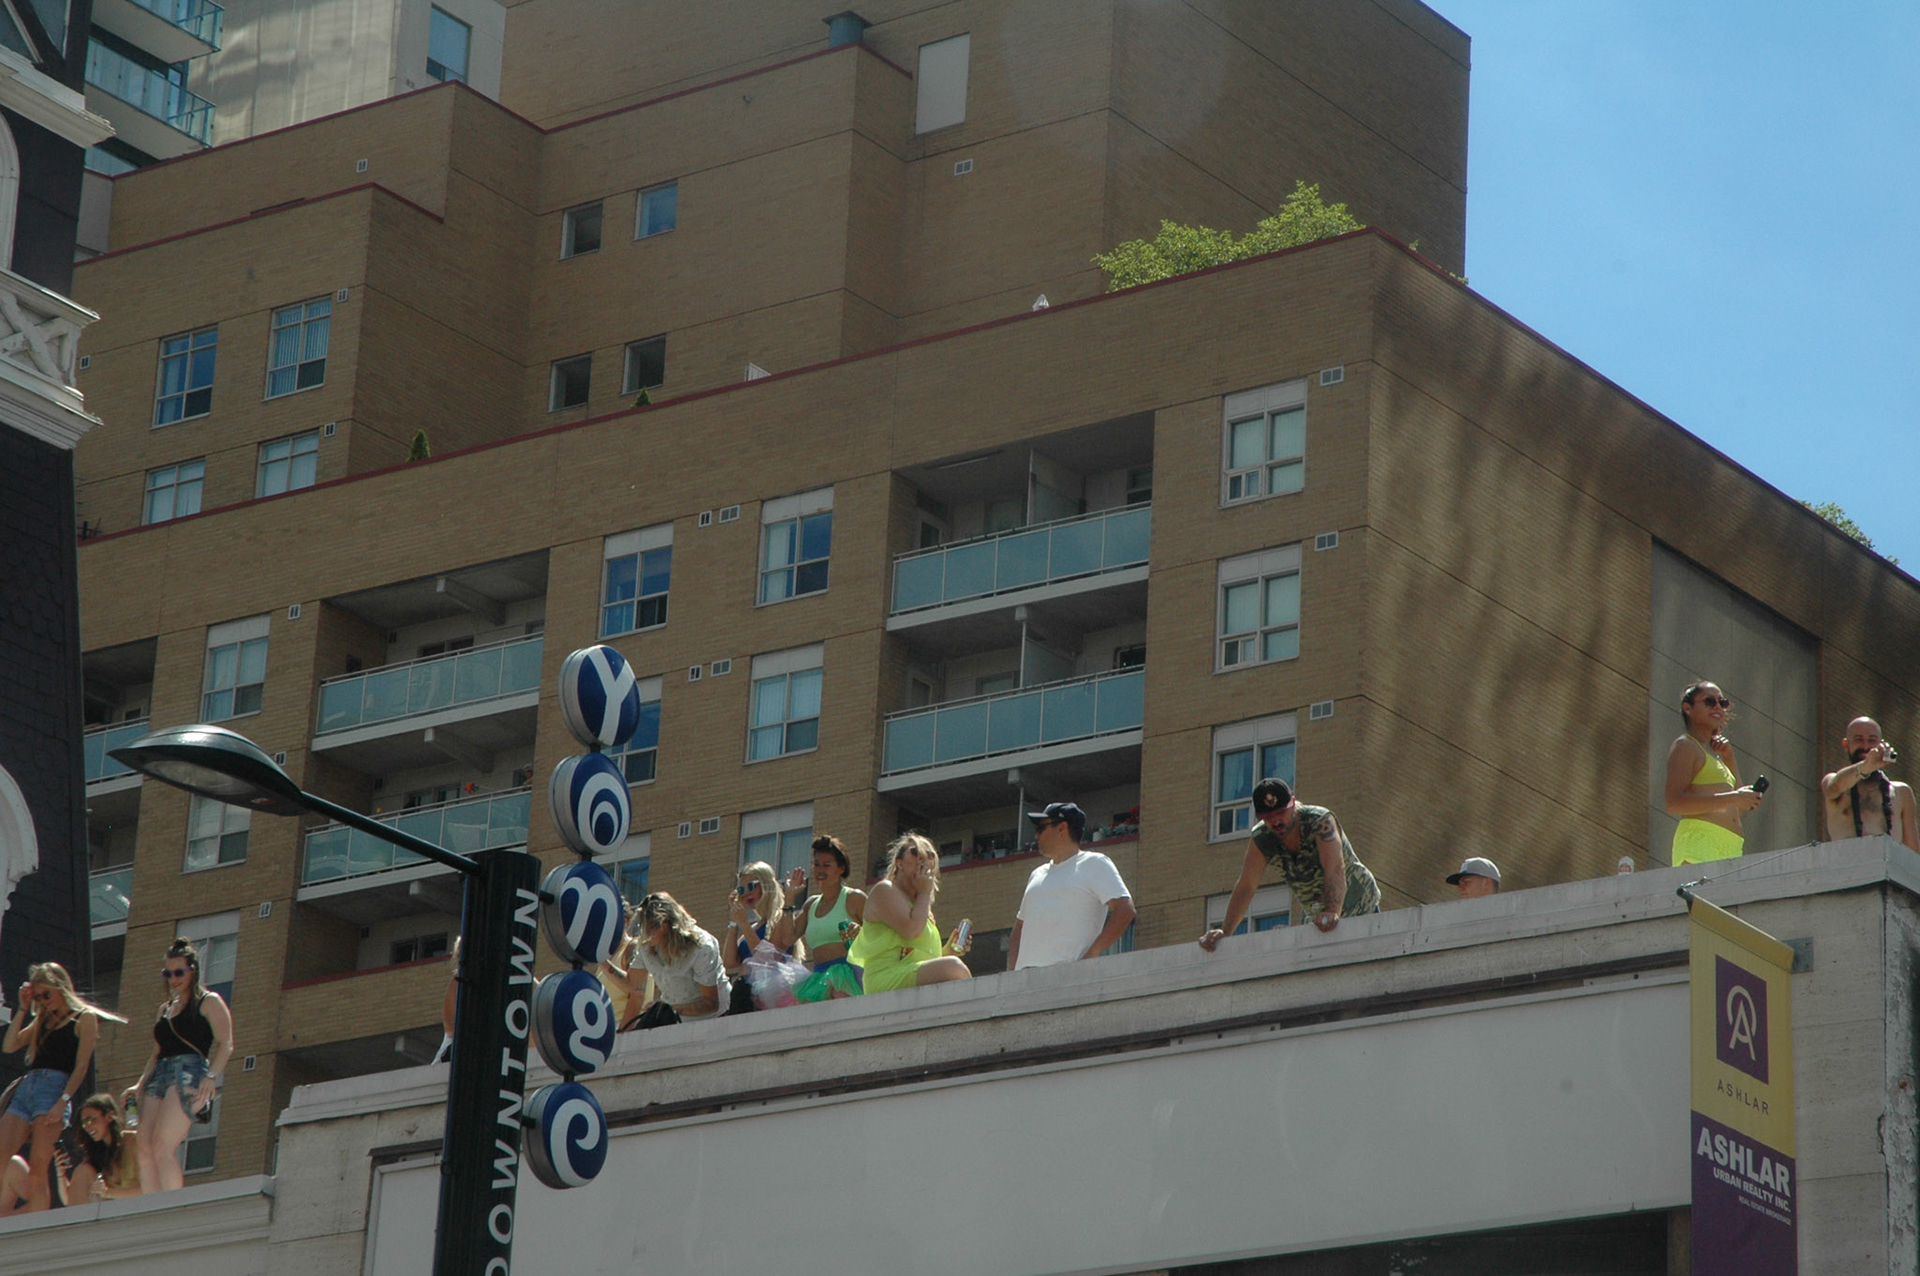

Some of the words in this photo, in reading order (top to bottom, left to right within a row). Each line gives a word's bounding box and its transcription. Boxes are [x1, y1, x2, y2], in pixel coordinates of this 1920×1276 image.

[1717, 1079, 1769, 1115] ASHLAR
[1697, 1127, 1791, 1197] ASHLAR
[1713, 1167, 1742, 1189] URBAN
[1743, 1181, 1773, 1204] REALTY
[1775, 1196, 1791, 1212] INC.
